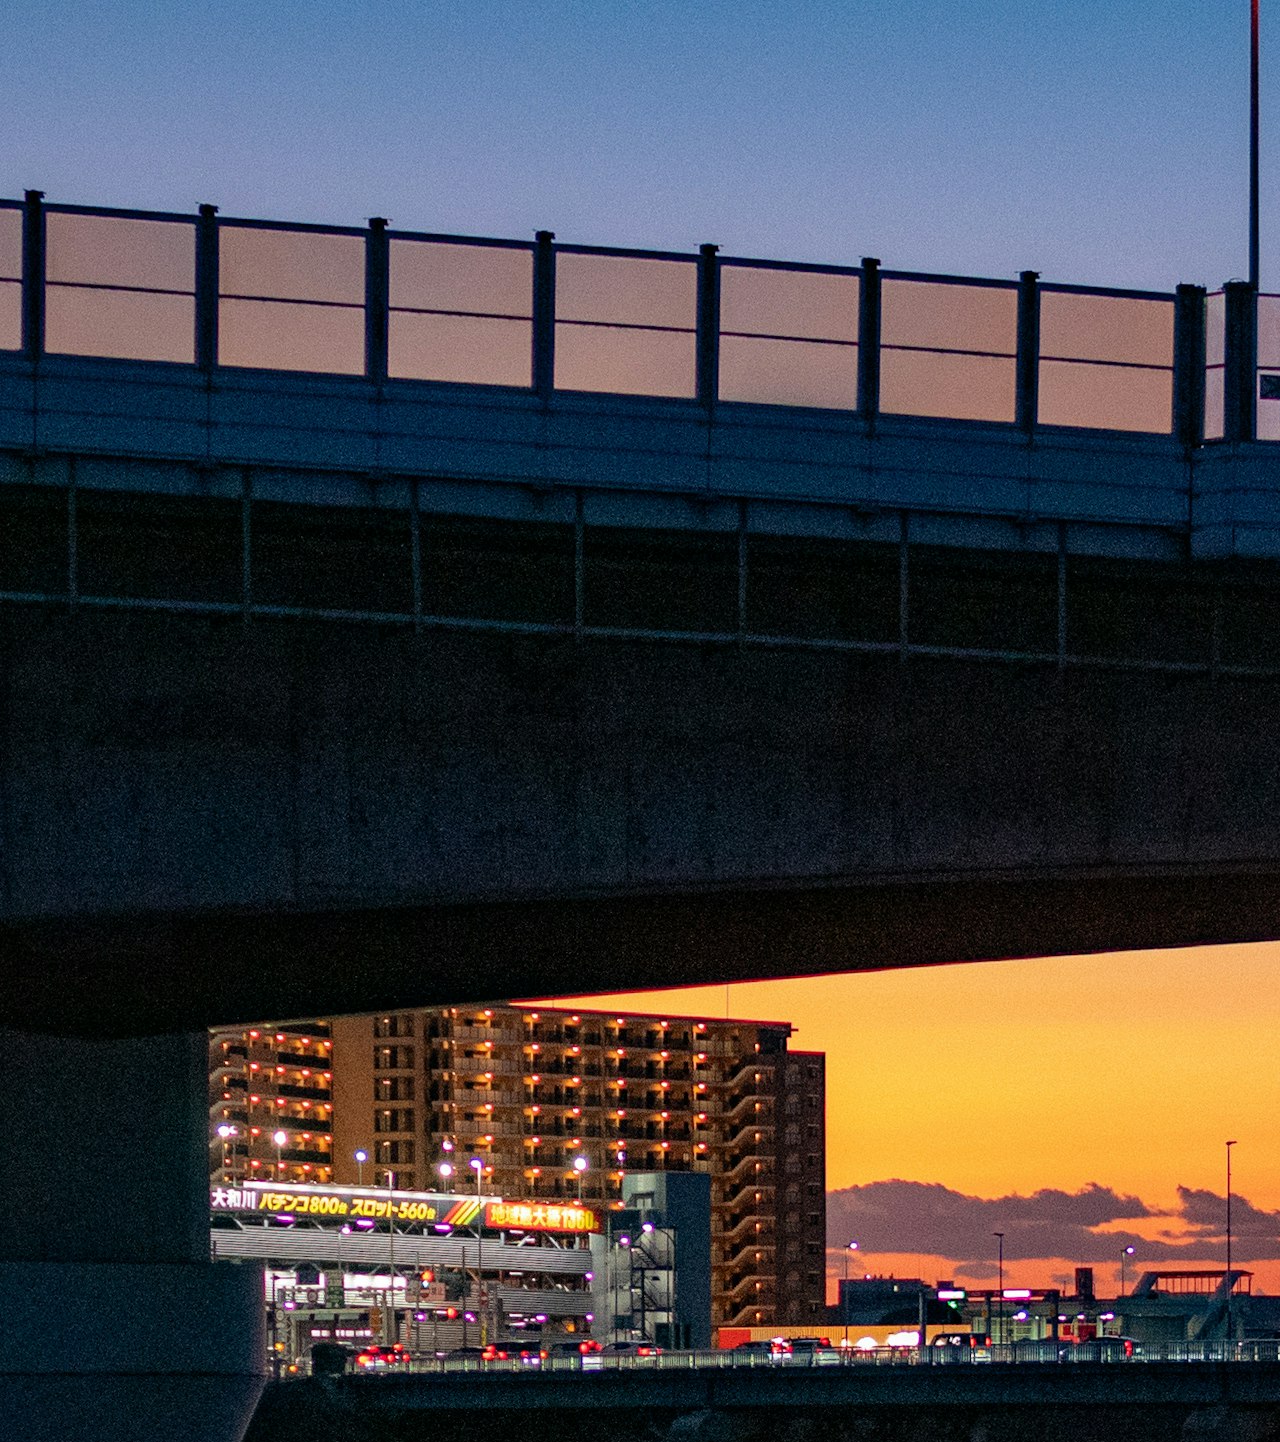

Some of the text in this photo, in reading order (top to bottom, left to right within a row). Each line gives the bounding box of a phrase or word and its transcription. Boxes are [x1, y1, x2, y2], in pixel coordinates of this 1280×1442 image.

[212, 1188, 436, 1219] 大和川 パチンコ800台 スロット560台
